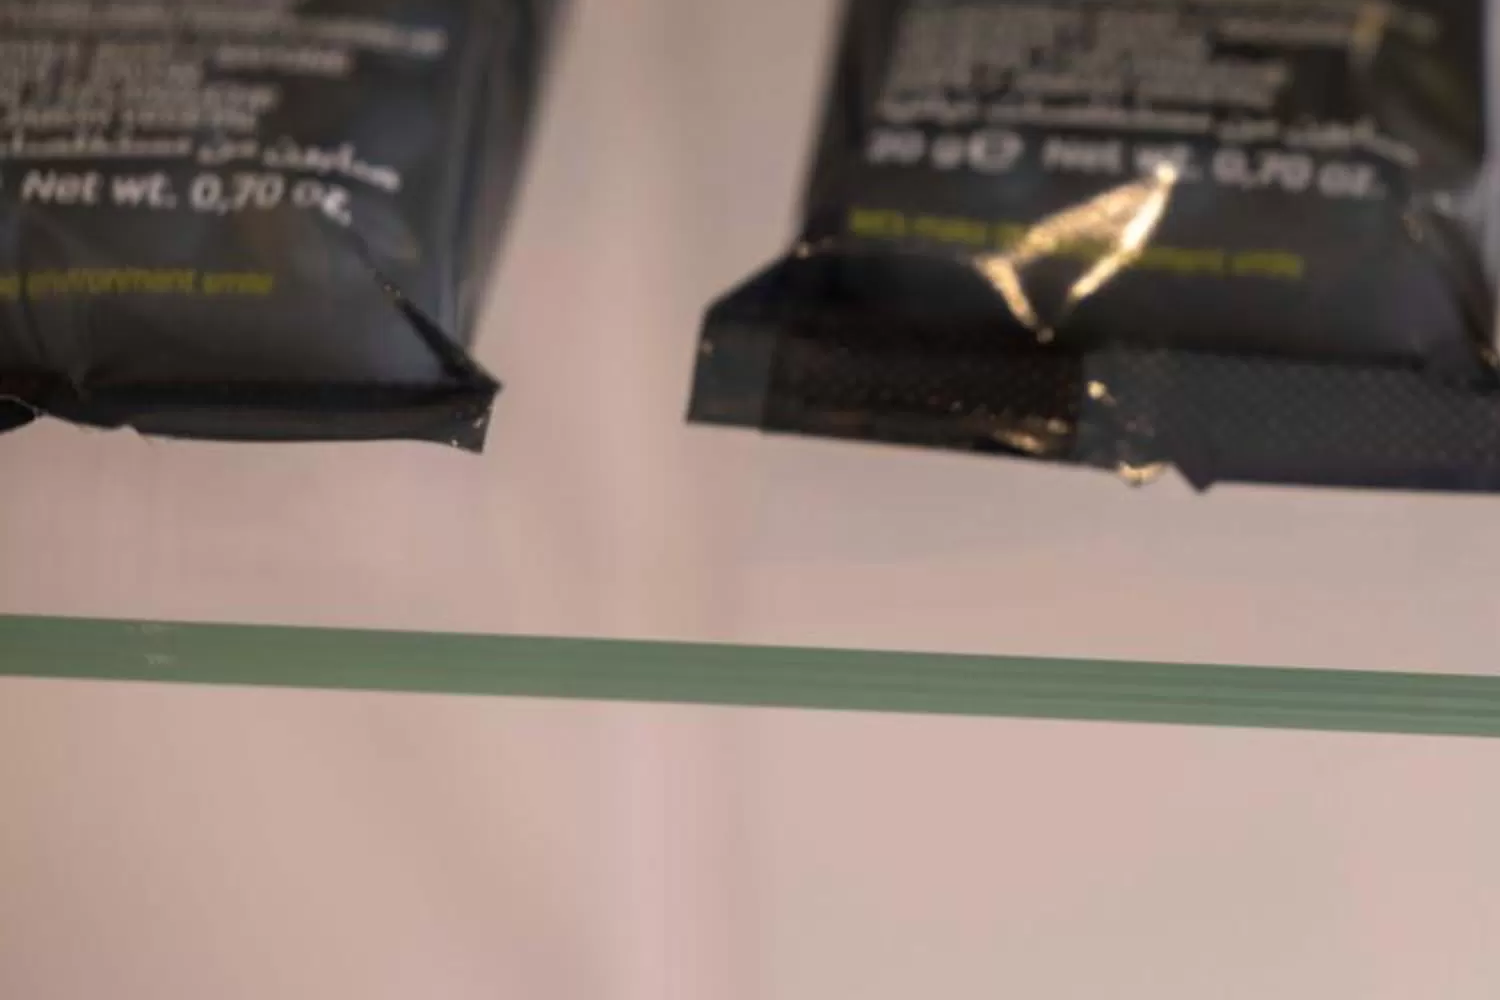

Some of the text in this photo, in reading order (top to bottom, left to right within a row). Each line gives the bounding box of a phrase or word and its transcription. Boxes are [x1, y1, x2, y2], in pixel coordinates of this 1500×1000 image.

[20, 169, 103, 204] Net
[110, 171, 178, 209] wt.
[188, 172, 286, 216] 0,70
